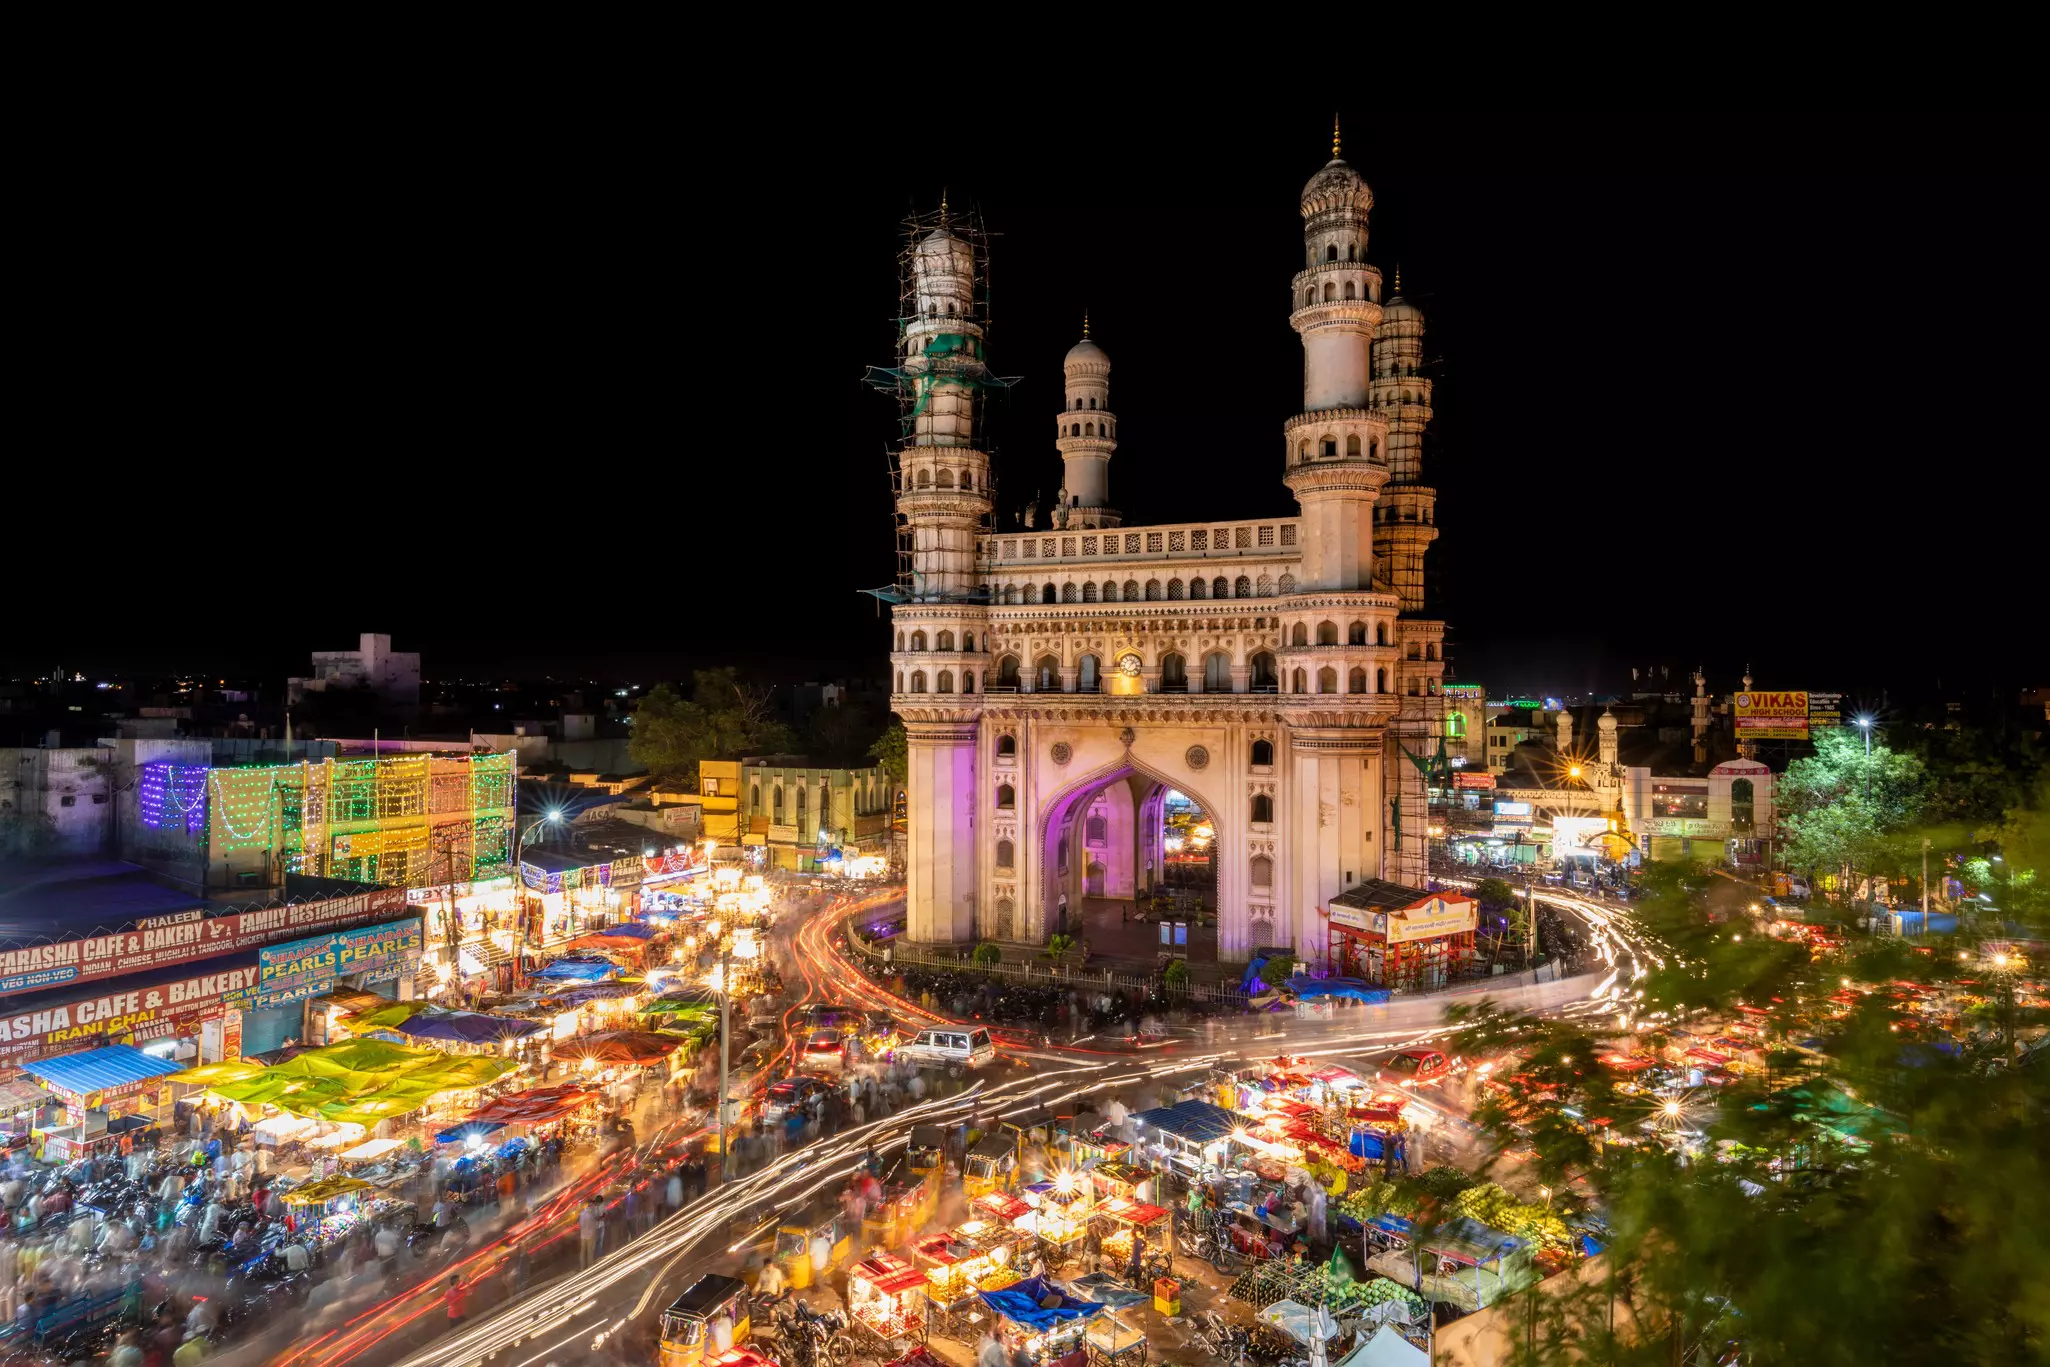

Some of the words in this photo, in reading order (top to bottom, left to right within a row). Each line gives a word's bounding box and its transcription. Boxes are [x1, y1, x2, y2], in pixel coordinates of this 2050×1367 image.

[1751, 693, 1807, 708] VIKAS
[147, 910, 201, 929] HALEEM
[0, 942, 80, 976] FARASHA
[83, 934, 125, 962] CAFE
[127, 935, 141, 953] &
[143, 922, 205, 952] BAKERY
[239, 908, 288, 934] FAMILY
[289, 894, 371, 924] RESTAURANT
[346, 928, 414, 949] SHAADAN
[1, 979, 24, 990] VEG
[26, 967, 74, 985] NON-VEG
[117, 955, 154, 970] CHINESE,
[190, 947, 197, 956] &
[267, 927, 295, 942] MUTTON
[269, 943, 331, 965] SHAADAN
[340, 934, 421, 964] PEARLS
[262, 952, 336, 980] PEARLS
[76, 991, 139, 1024] CAFE
[145, 990, 164, 1009] &
[168, 967, 257, 1004] BAKERY
[223, 990, 244, 1002] NON
[175, 1002, 199, 1014] MUTTON
[47, 1022, 103, 1044] IRANI
[109, 1009, 155, 1030] CHAI
[134, 1022, 174, 1042] HALEEM
[47, 1082, 72, 1097] HALEEM
[104, 1082, 143, 1099] HALEEM
